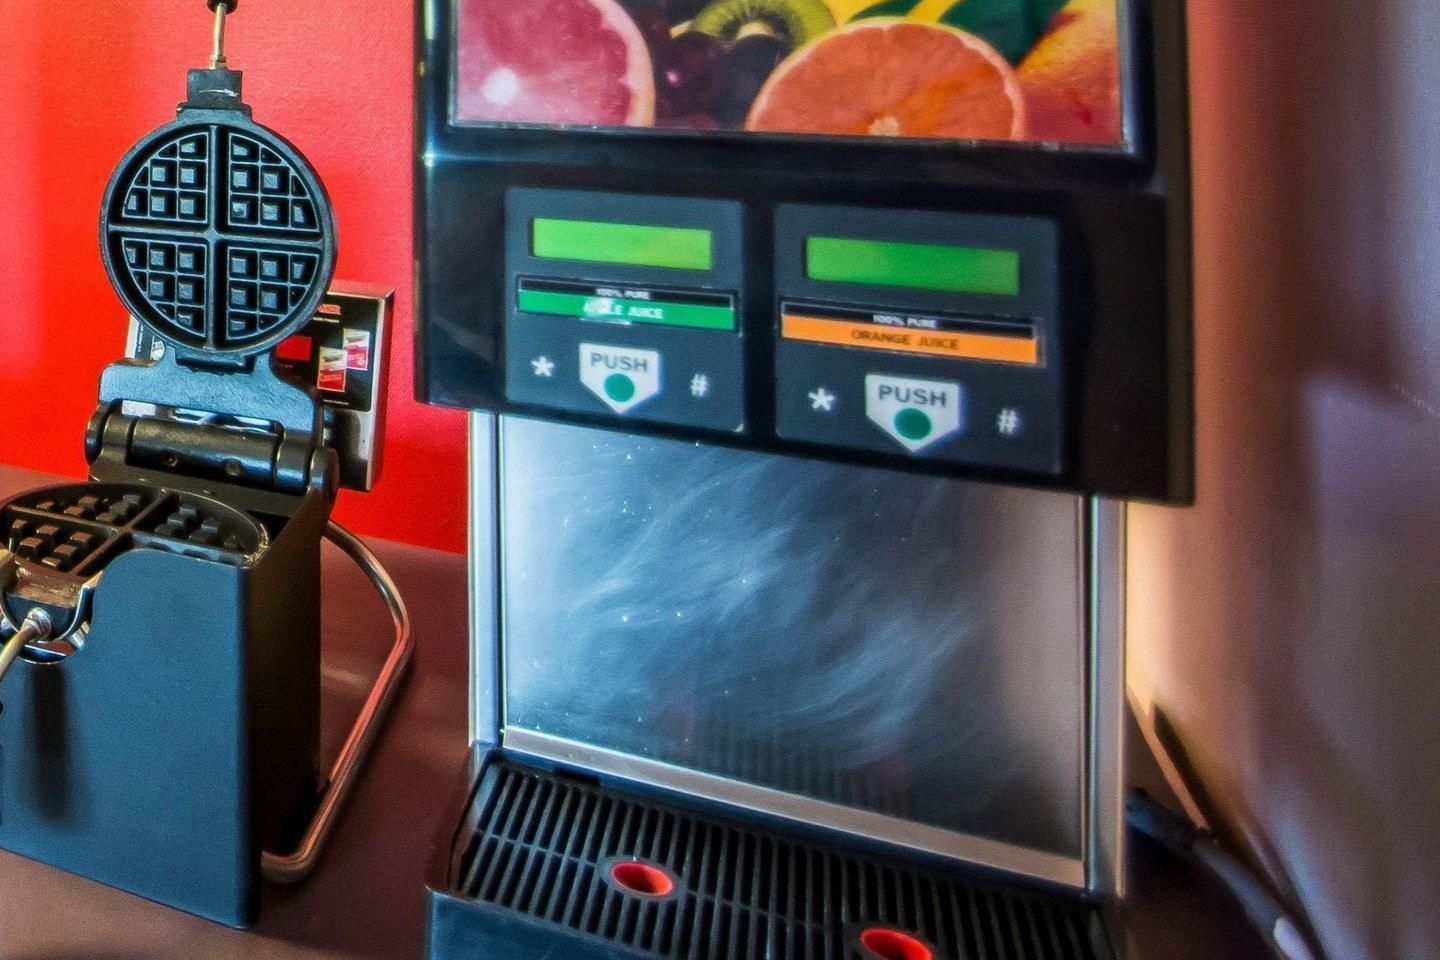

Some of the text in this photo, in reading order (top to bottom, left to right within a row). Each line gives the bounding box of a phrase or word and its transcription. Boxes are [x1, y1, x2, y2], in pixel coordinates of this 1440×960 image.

[851, 329, 959, 350] ORANGE JUICE
[590, 352, 648, 373] PUSH
[879, 384, 947, 408] PUSH
